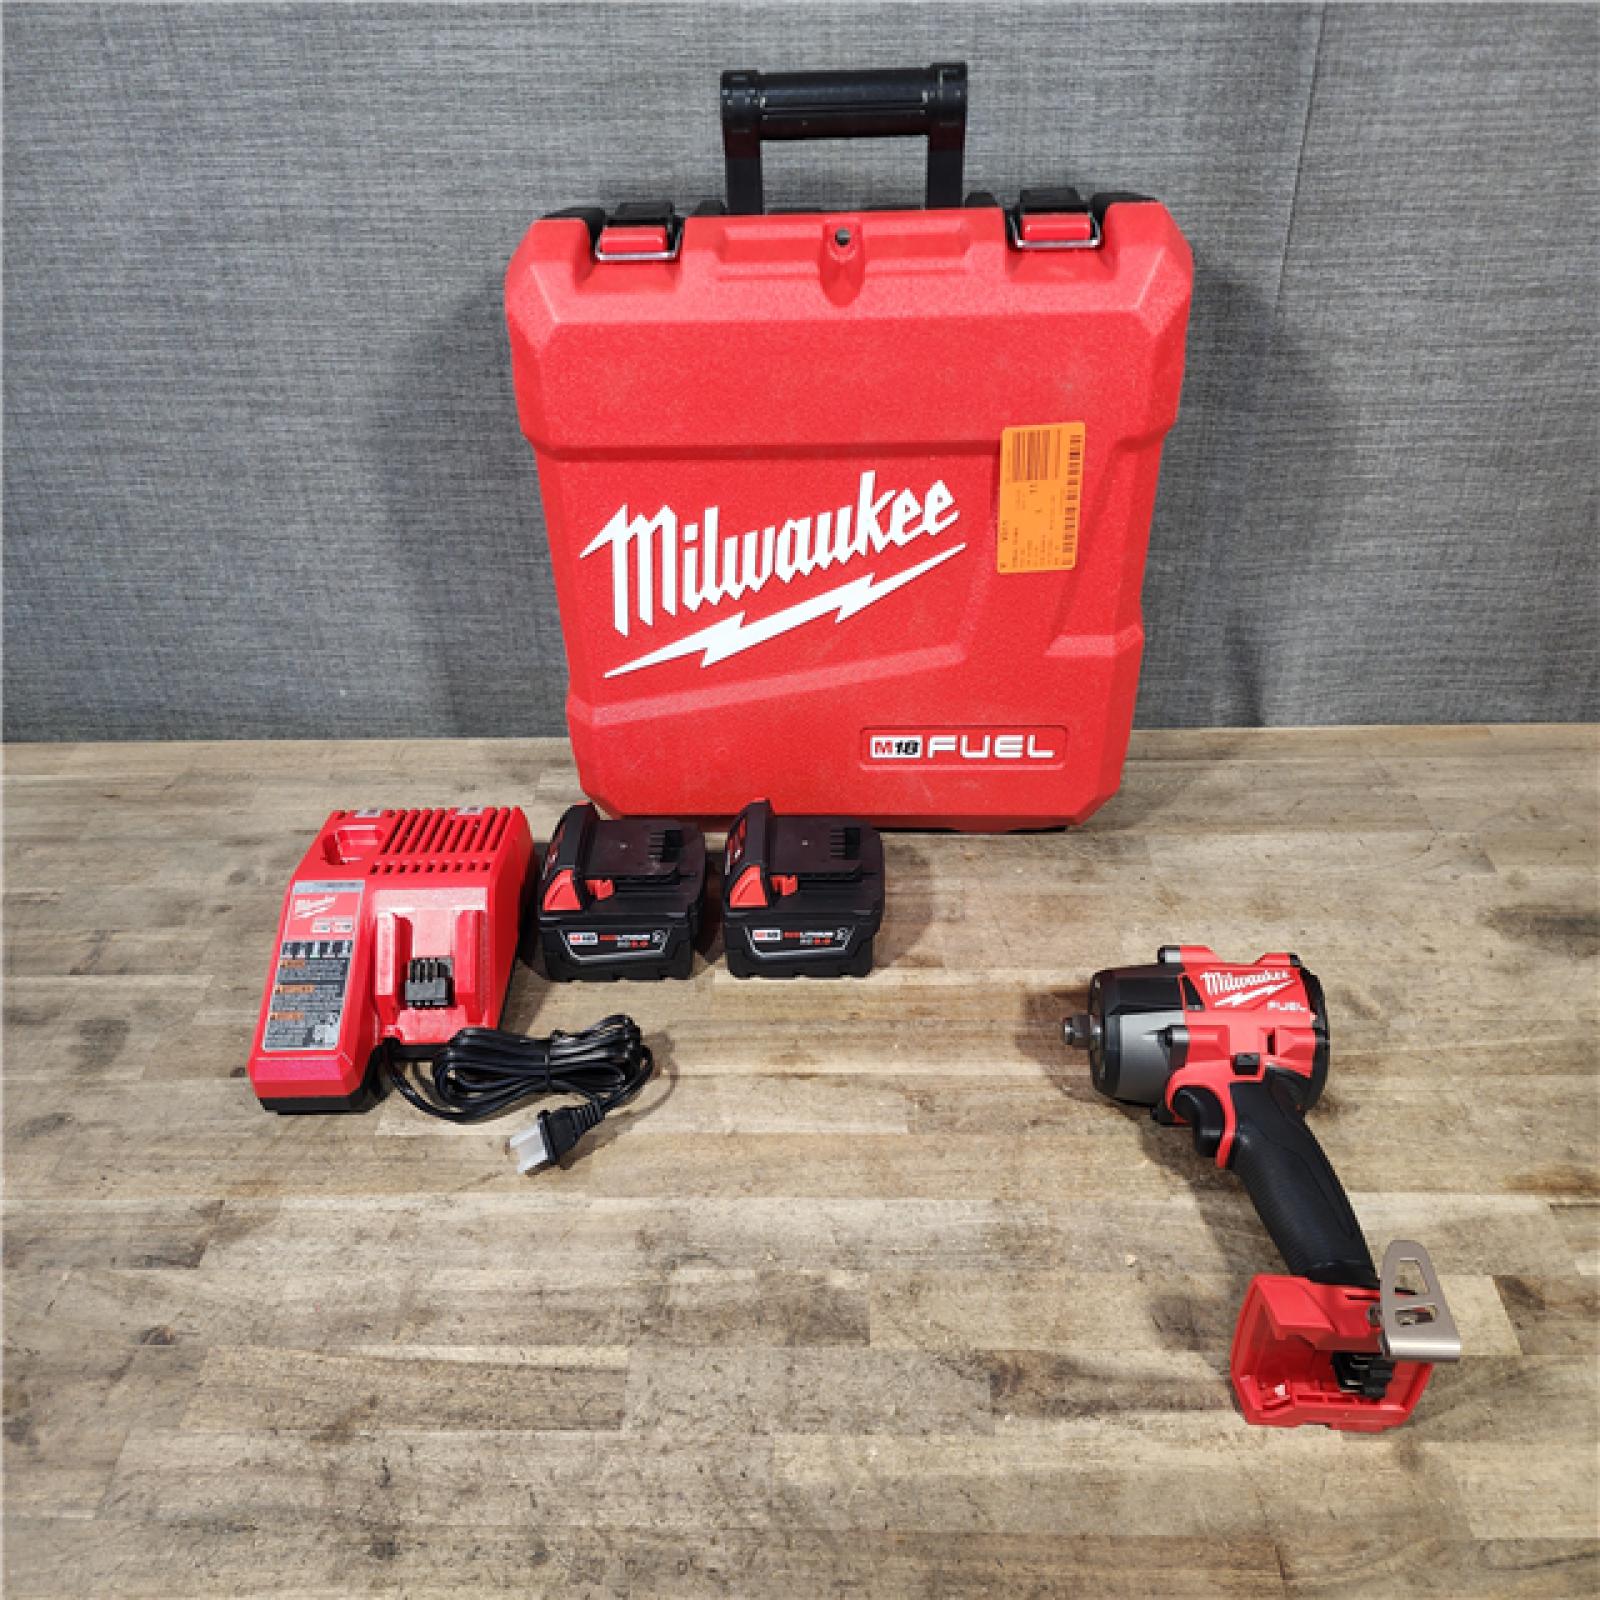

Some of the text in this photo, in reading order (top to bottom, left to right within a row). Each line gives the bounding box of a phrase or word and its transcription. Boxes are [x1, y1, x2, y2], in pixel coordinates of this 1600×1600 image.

[579, 470, 960, 637] Milwaukee
[873, 734, 1056, 759] M18 FUEL
[1200, 969, 1291, 996] Milwaukee
